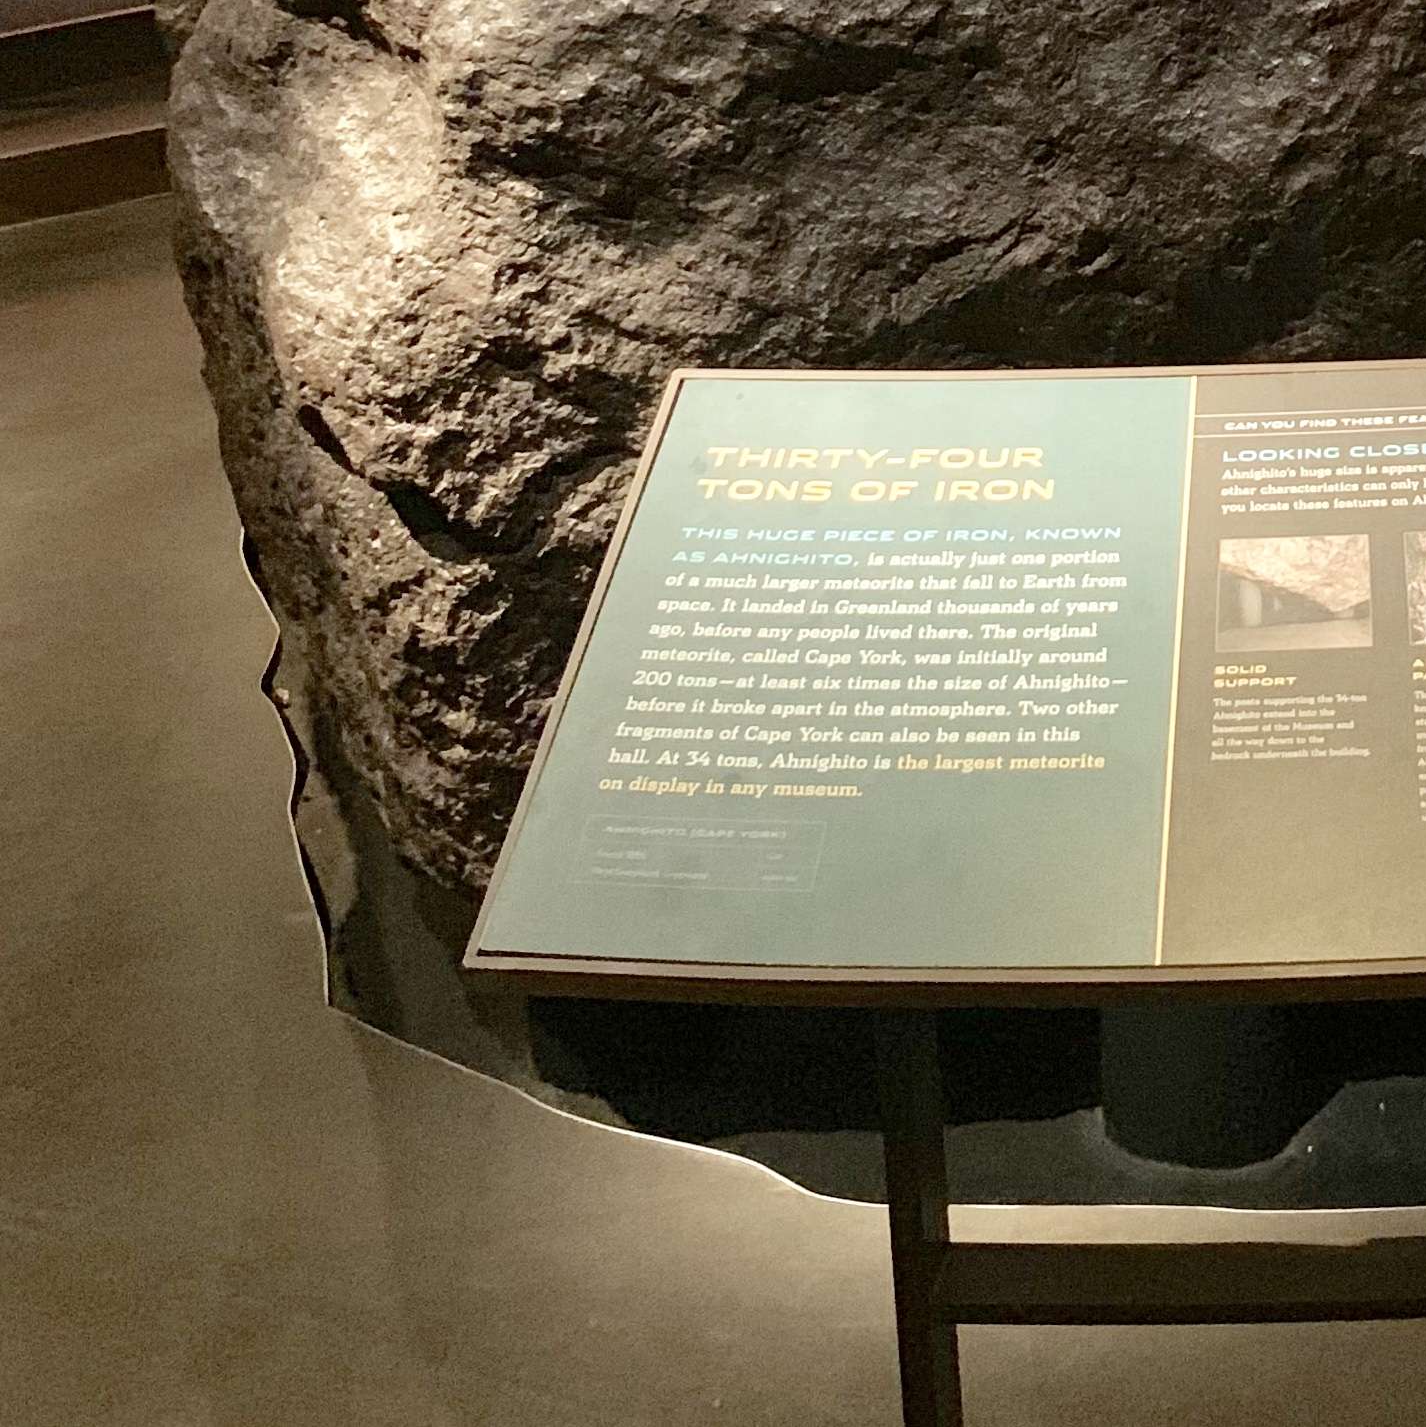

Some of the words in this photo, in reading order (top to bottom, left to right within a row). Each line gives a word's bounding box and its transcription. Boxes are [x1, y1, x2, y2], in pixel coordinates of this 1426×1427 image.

[1224, 422, 1257, 430] CAN
[1261, 421, 1295, 429] YOU
[1300, 419, 1337, 427] FIND
[1341, 416, 1393, 426] THESE
[707, 447, 1043, 469] THIRTY-FOUR
[1223, 447, 1339, 461] LOOKING
[1300, 467, 1331, 478] huge
[1335, 466, 1361, 475] size
[1366, 464, 1377, 474] is
[697, 479, 832, 501] TONS
[850, 481, 918, 501] OF
[934, 479, 1054, 501] IRON
[1221, 485, 1256, 495] other
[1260, 482, 1358, 494] characteristics
[1363, 482, 1386, 490] can
[1390, 478, 1419, 490] only
[1221, 504, 1245, 514] you
[1250, 501, 1289, 511] locate
[1293, 499, 1329, 510] these
[1333, 498, 1387, 508] features
[1391, 498, 1408, 506] on
[682, 527, 738, 539] THIS
[747, 529, 815, 541] HUGE
[824, 530, 895, 541] PIECE
[903, 530, 938, 541] OF
[946, 530, 1014, 541] IRON,
[1025, 527, 1120, 539] KNOWN
[672, 551, 705, 562] AS
[713, 552, 858, 566] AHNIGHITO,
[867, 552, 884, 565] is
[889, 550, 966, 568] actually
[969, 551, 1006, 568] just
[1011, 554, 1045, 564] one
[1050, 549, 1119, 567] portion
[665, 572, 685, 586] of
[688, 577, 699, 586] a
[704, 574, 757, 588] much
[761, 574, 819, 592] larger
[823, 576, 913, 590] meteorite
[919, 575, 957, 590] that
[962, 574, 993, 589] fell
[999, 576, 1017, 589] to
[1022, 573, 1075, 589] Earth
[1081, 573, 1127, 588] from
[657, 600, 714, 613] space.
[721, 598, 736, 612] It
[741, 598, 805, 613] landed
[809, 600, 828, 614] in
[834, 599, 932, 614] Greenland
[937, 598, 1034, 614] thousands
[1040, 598, 1060, 613] of
[1065, 601, 1118, 616] years
[649, 624, 685, 638] ago,
[692, 622, 752, 637] before
[757, 628, 793, 641] any
[796, 624, 860, 642] people
[865, 624, 913, 639] lived
[918, 624, 973, 639] there.
[980, 624, 1016, 638] The
[1022, 622, 1097, 641] original
[640, 648, 735, 663] meteorite,
[742, 648, 800, 663] called
[805, 649, 851, 667] Cape
[859, 650, 906, 666] York,
[914, 654, 951, 664] was
[957, 649, 1033, 667] initially
[1038, 647, 1107, 663] around
[1413, 659, 1424, 667] A
[1214, 665, 1266, 674] SOLID
[632, 670, 672, 685] 200
[760, 674, 806, 689] least
[812, 676, 841, 689] six
[847, 676, 900, 690] times
[907, 675, 938, 690] the
[943, 676, 982, 690] size
[988, 675, 1008, 690] of
[1214, 676, 1296, 687] SUPPORT
[625, 695, 685, 712] before
[691, 699, 705, 713] it
[710, 698, 766, 714] broke
[771, 703, 822, 718] apart
[828, 701, 847, 715] in
[854, 701, 884, 716] the
[890, 701, 1011, 719] atmosphere.
[1018, 700, 1060, 715] Two
[1066, 699, 1119, 714] other
[615, 721, 713, 741] fragments
[719, 725, 739, 740] of
[744, 726, 791, 744] Cape
[800, 726, 843, 742] York
[849, 731, 883, 742] can
[889, 727, 930, 742] also
[936, 727, 959, 742] be
[965, 731, 1010, 742] seen
[1017, 727, 1036, 742] in
[1043, 726, 1080, 741] this
[608, 747, 649, 764] hall.
[655, 750, 679, 765] At
[685, 751, 710, 766] 34
[716, 754, 762, 769] tons,
[769, 752, 867, 772] Ahnighito
[873, 754, 891, 769] is
[897, 754, 928, 769] the
[935, 754, 1002, 773] largest
[1009, 754, 1104, 769] meteorite
[599, 779, 623, 790] on
[628, 775, 701, 796] display
[704, 779, 724, 794] in
[730, 784, 768, 798] any
[773, 785, 862, 796] museum.
